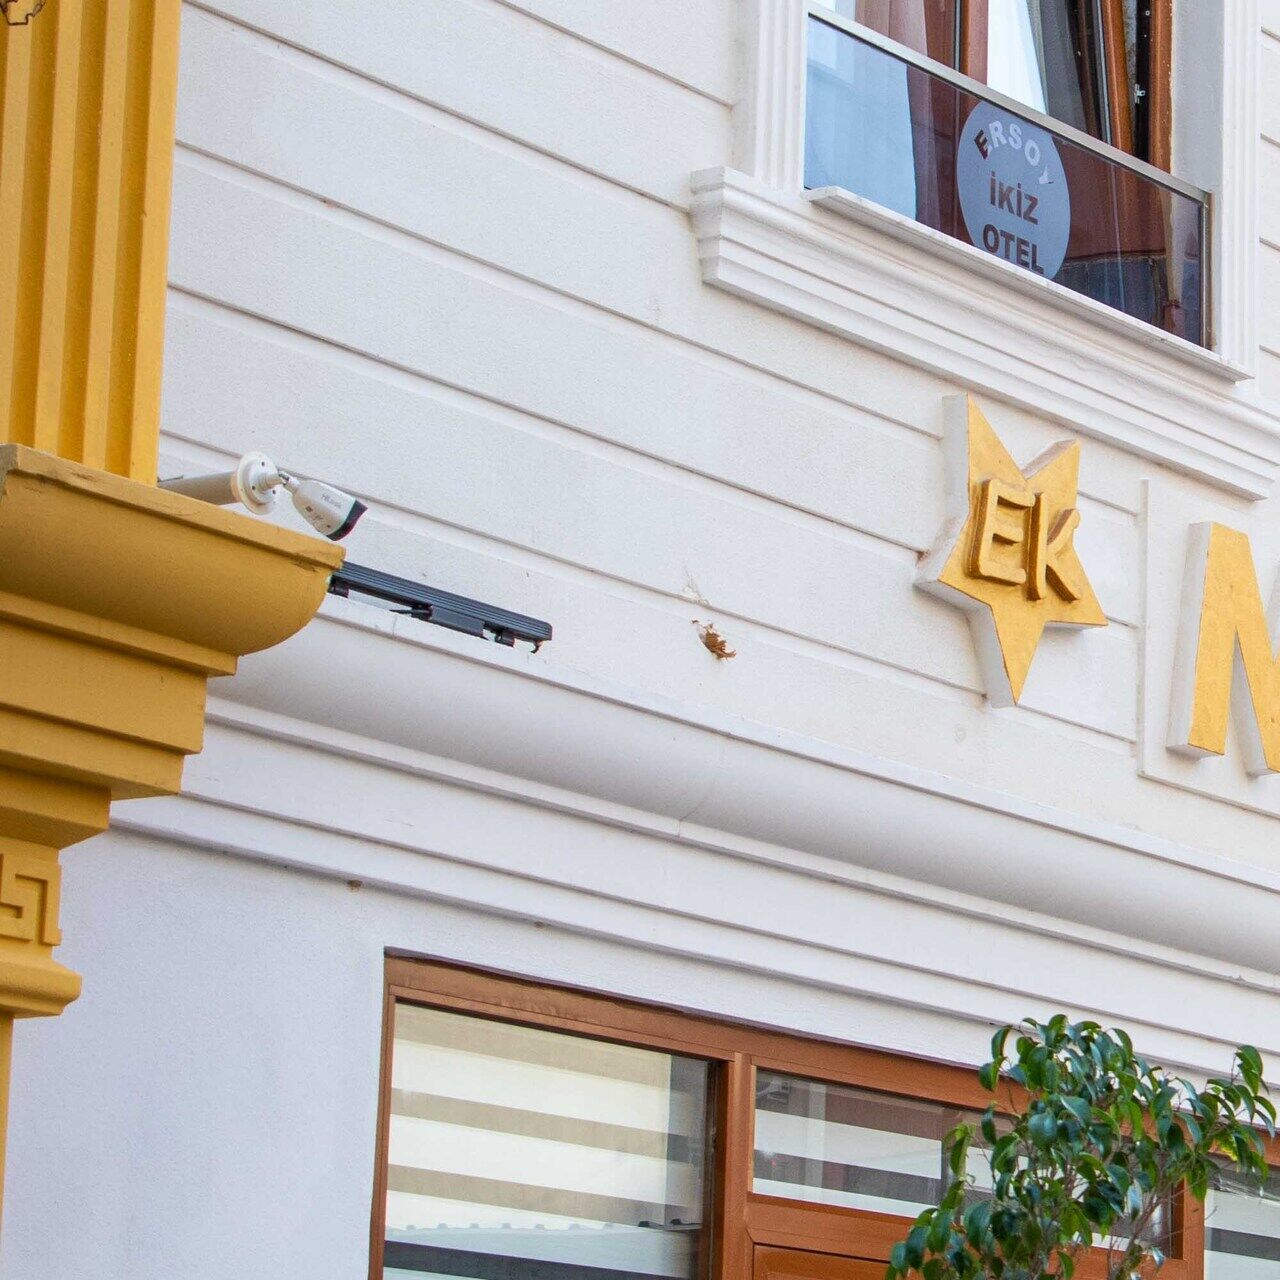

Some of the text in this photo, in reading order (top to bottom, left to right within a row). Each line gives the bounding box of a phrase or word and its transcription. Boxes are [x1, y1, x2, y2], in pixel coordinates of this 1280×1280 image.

[988, 170, 1039, 225] İKİZ
[983, 223, 1045, 275] OTEL
[968, 477, 1082, 603] EK
